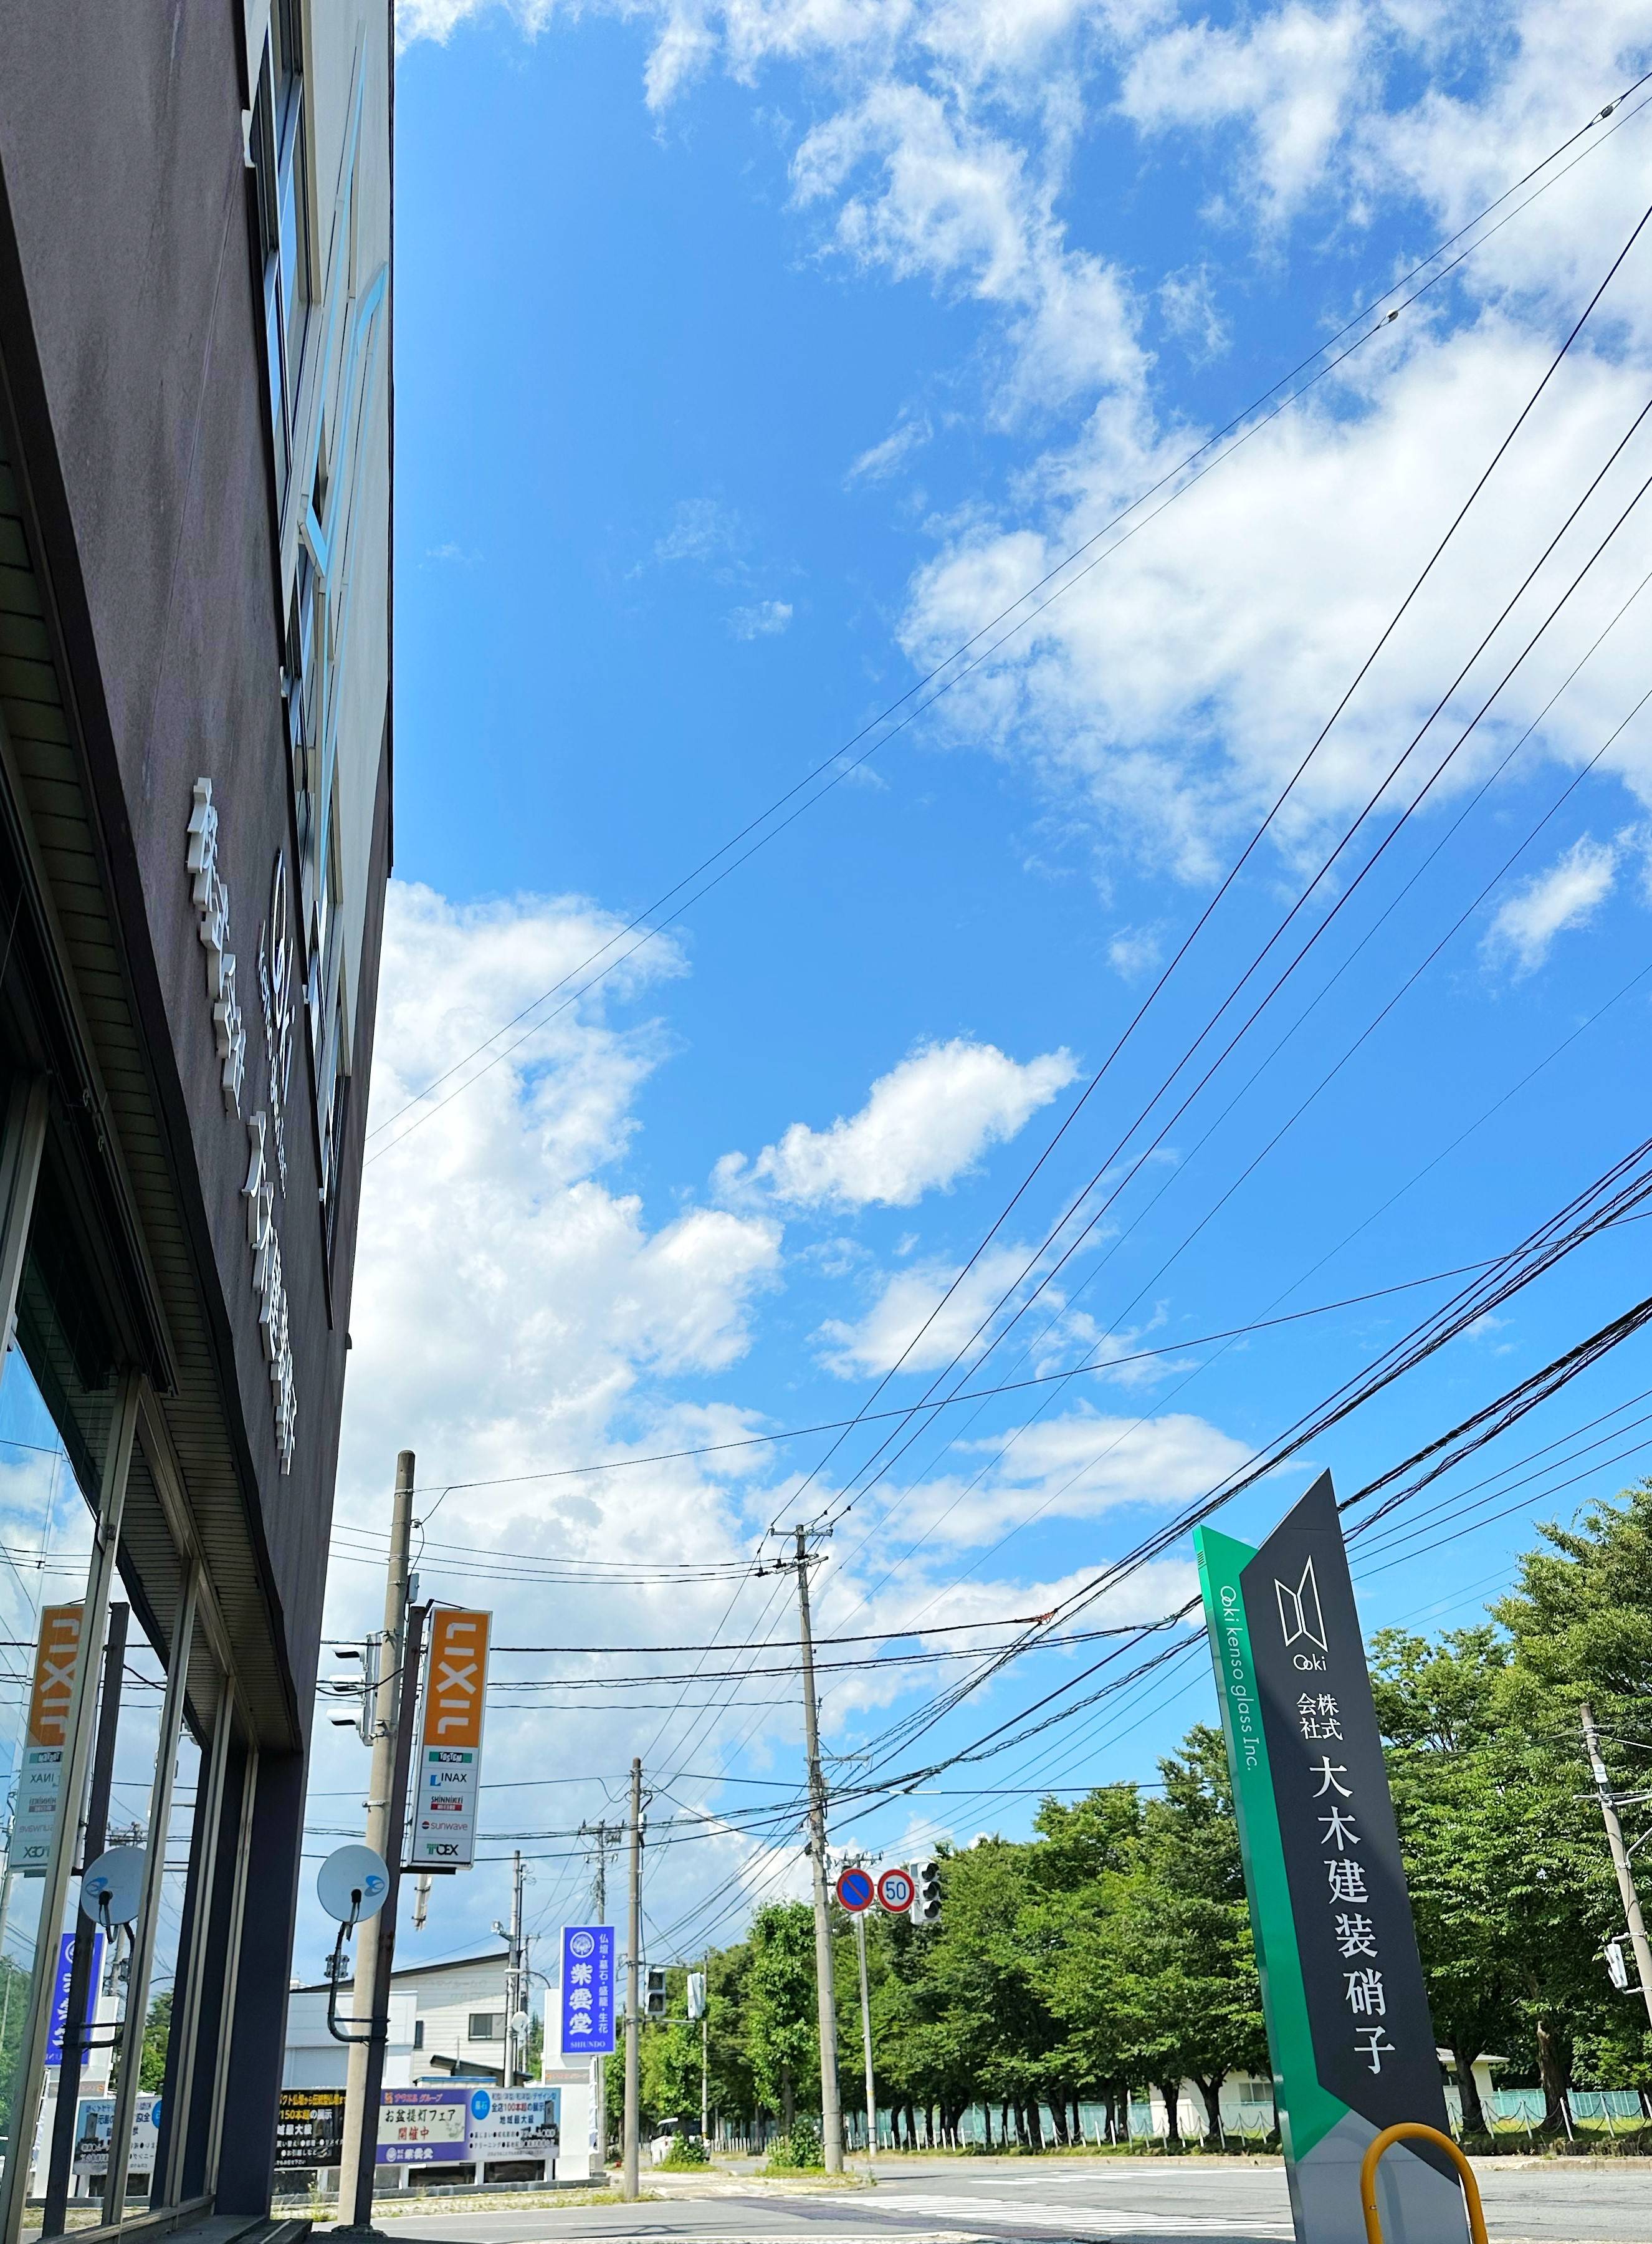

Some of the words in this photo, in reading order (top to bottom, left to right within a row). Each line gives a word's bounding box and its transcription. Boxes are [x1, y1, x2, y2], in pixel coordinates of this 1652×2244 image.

[1220, 1585, 1240, 1622] Ooki
[1226, 1627, 1244, 1681] kenso
[1293, 1653, 1327, 1671] Ooki
[436, 1622, 478, 1735] LIXIL
[1230, 1685, 1254, 1733] glass
[1243, 1737, 1259, 1771] Inc.
[431, 1821, 468, 1831] sunwave
[886, 1881, 906, 1900] 50
[1309, 1755, 1395, 2074] 大木建装硝子
[385, 2109, 456, 2122] お盆提灯フェア
[398, 2126, 429, 2141] 開催中
